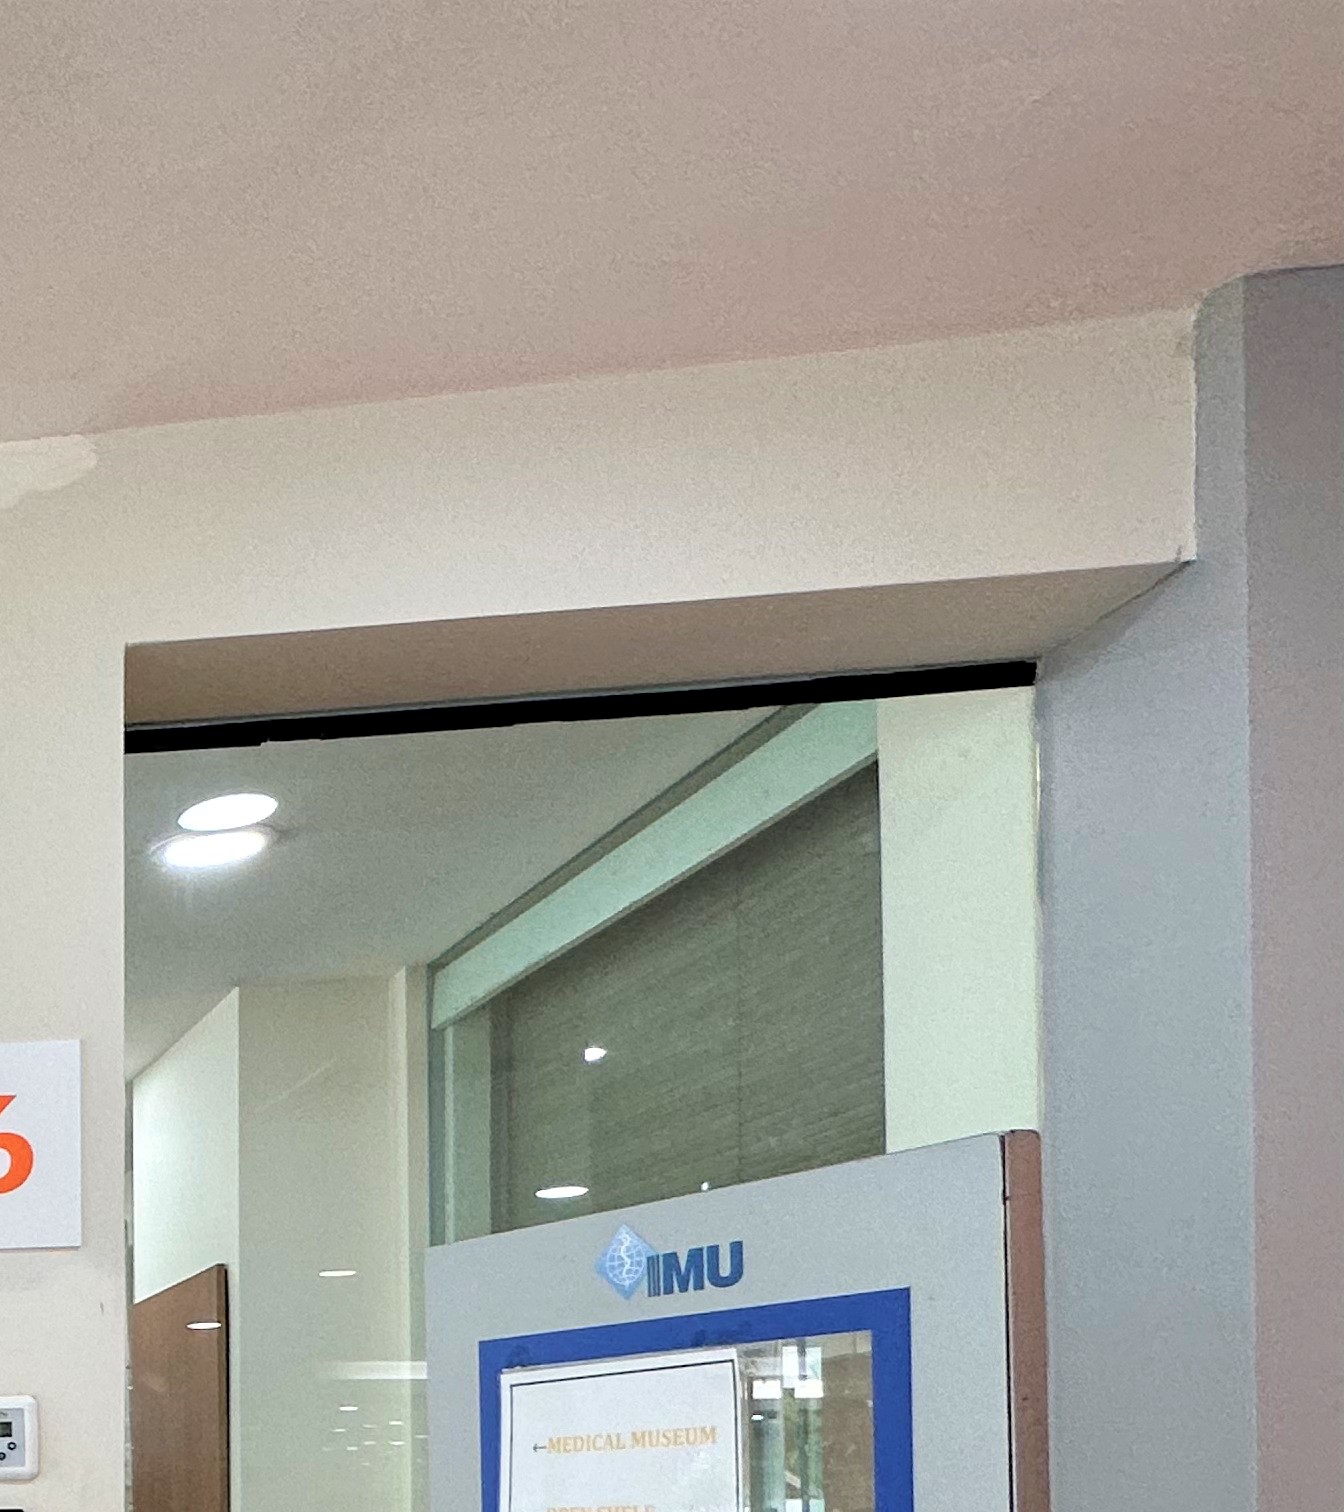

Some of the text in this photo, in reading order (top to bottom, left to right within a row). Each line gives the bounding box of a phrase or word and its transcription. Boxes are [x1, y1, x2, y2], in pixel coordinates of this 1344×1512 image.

[647, 1240, 744, 1298] IMU
[547, 1426, 718, 1454] MEDICAL MUSEUM
